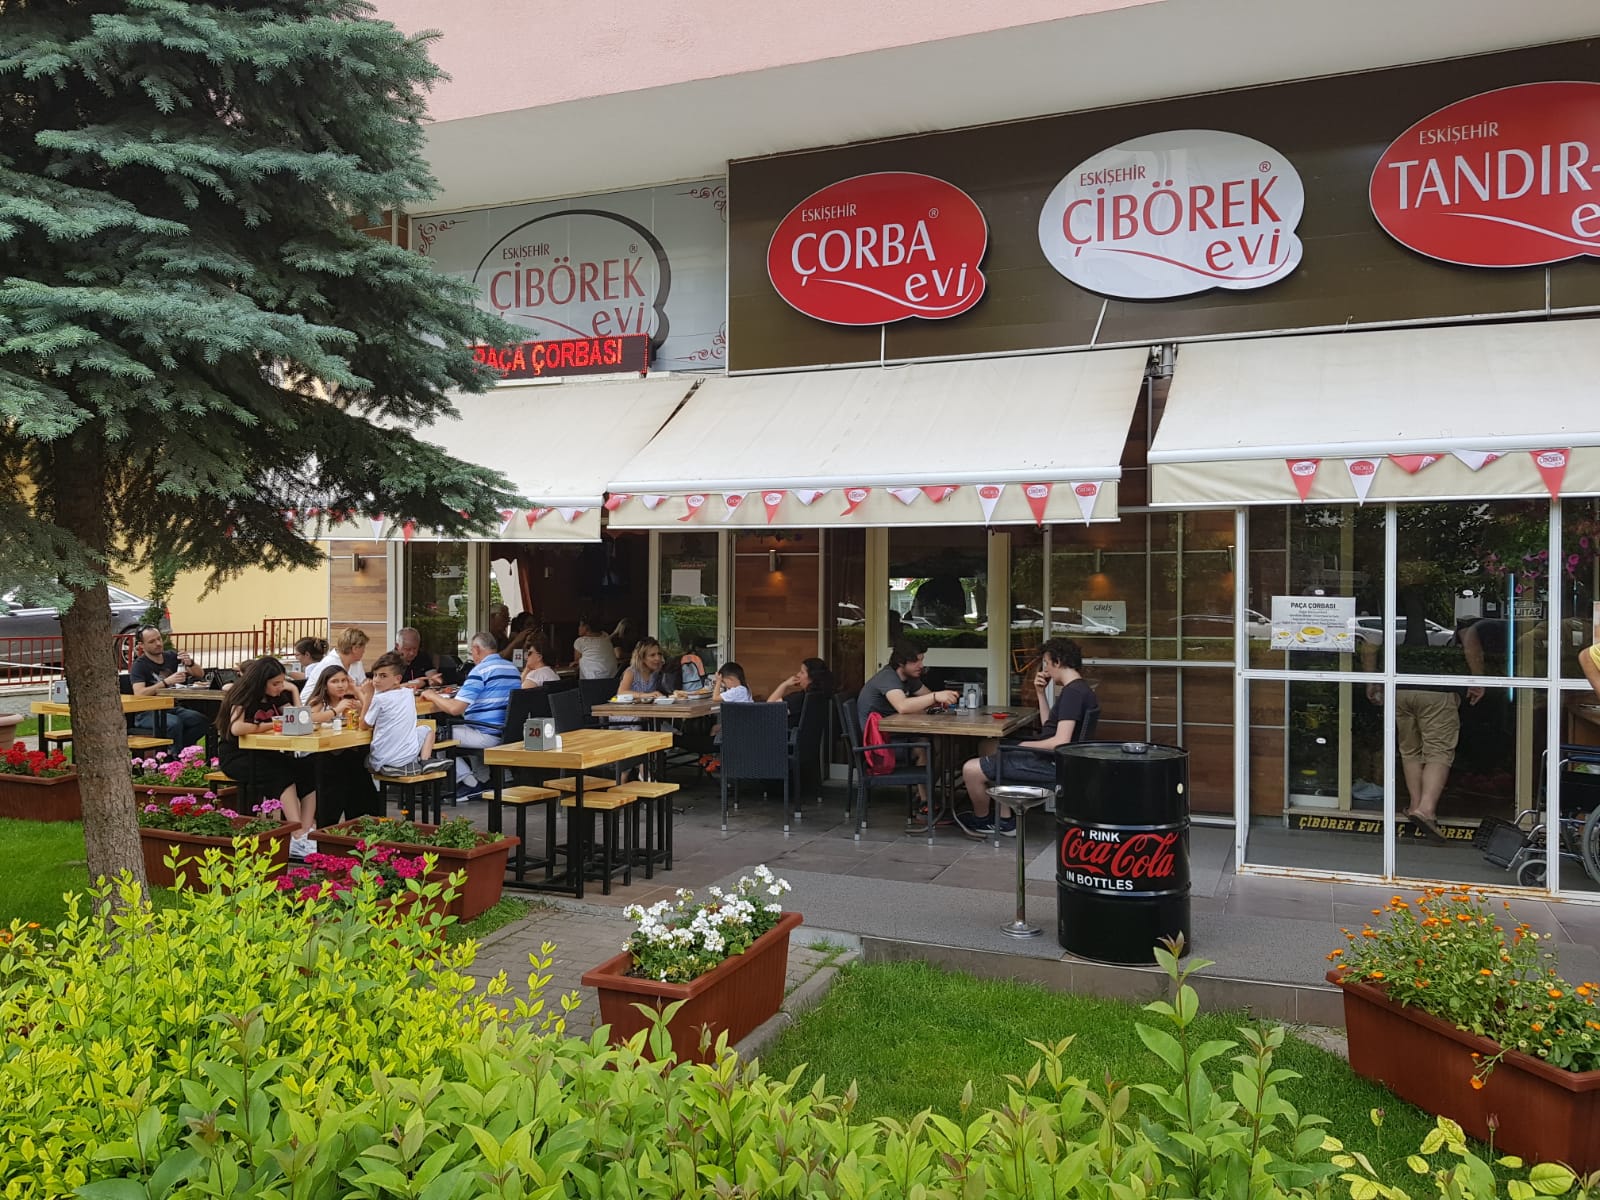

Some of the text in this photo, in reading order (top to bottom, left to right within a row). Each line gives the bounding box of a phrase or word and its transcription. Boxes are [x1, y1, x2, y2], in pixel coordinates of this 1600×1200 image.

[1419, 121, 1499, 145] ESKİŞEHİR
[1080, 164, 1146, 187] ESKİŞEHİR
[802, 203, 857, 223] ESKİŞEHİR
[1062, 175, 1282, 257] ÇİBÖREK
[502, 243, 550, 261] ESKİŞEHİR
[791, 220, 936, 287] ÇORBA
[1205, 228, 1281, 272] evi
[490, 256, 646, 319] ÇİBÖREK
[905, 263, 968, 302] evi
[592, 302, 645, 337] evi
[532, 338, 623, 376] ÇORBASI
[1290, 602, 1336, 610] PAÇA ÇORBASI
[285, 714, 295, 724] 10
[528, 727, 541, 739] 20
[1298, 815, 1356, 830] ÇİBÖREK
[1357, 820, 1381, 833] EVİ
[1081, 829, 1121, 843] RINK
[1066, 870, 1134, 891] IN BOTTLES
